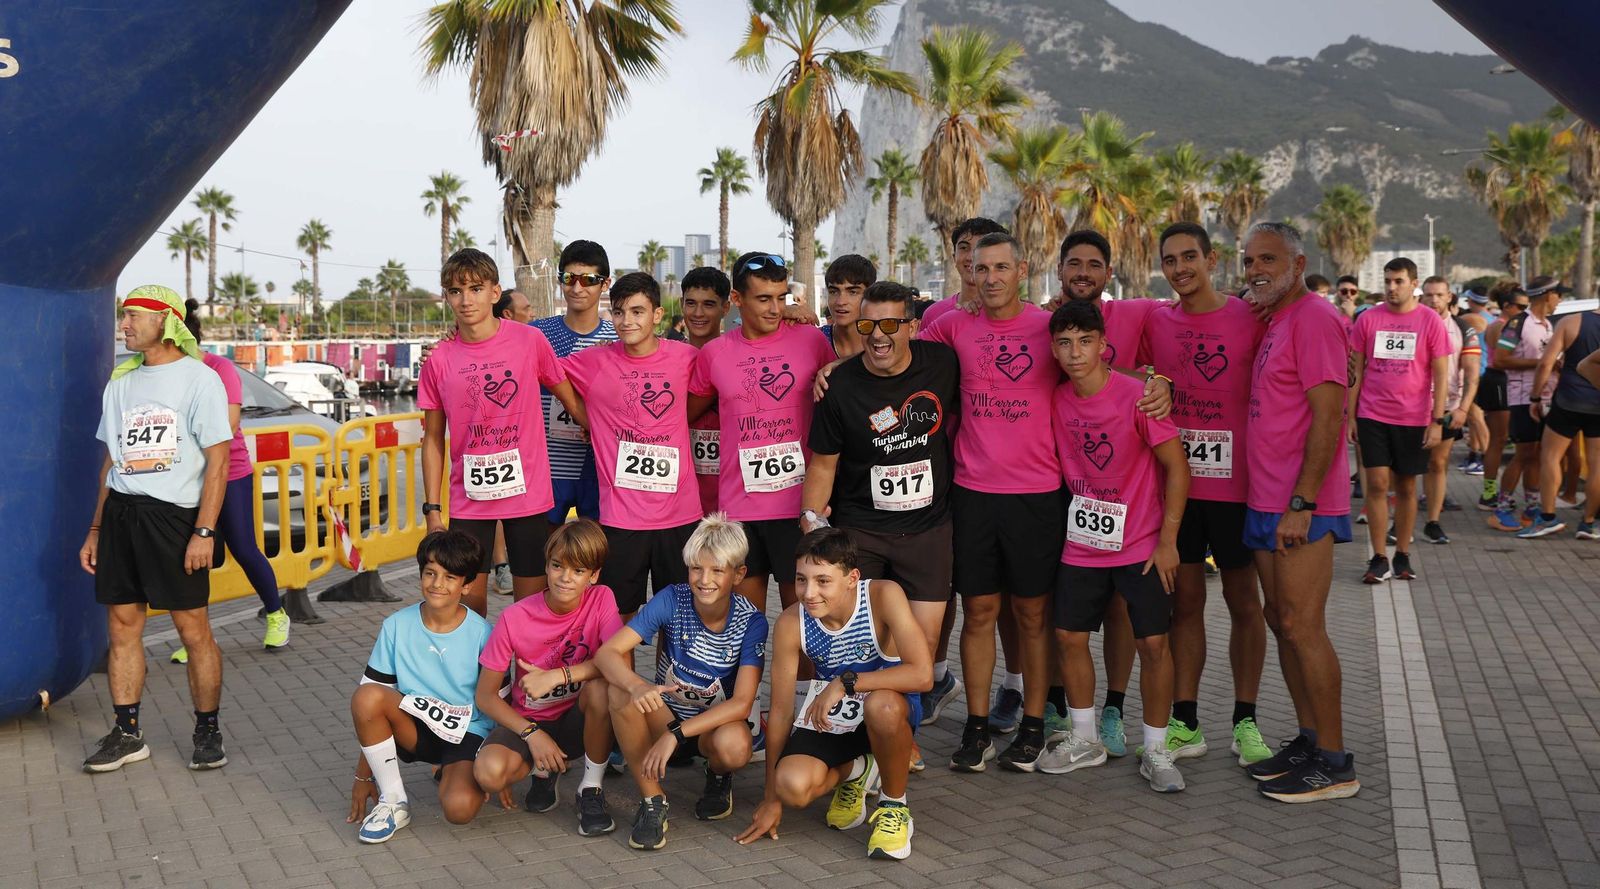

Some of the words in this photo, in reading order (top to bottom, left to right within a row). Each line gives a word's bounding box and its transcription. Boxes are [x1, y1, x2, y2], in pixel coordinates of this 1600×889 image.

[1386, 339, 1405, 350] 84
[970, 393, 988, 407] VIII
[988, 396, 1030, 408] Carrera
[738, 416, 756, 431] VIII
[756, 418, 793, 429] Carrera
[972, 408, 982, 417] de
[984, 408, 993, 417] la
[996, 408, 1031, 423] Mujer
[126, 426, 168, 446] 547
[484, 424, 518, 435] Carrera
[741, 432, 751, 441] de
[753, 431, 762, 440] la
[764, 428, 795, 442] Mujer
[468, 440, 478, 448] de
[481, 438, 490, 446] la
[635, 434, 671, 443] Carrera
[872, 432, 908, 447] Turismo
[884, 434, 928, 455] Running
[695, 442, 720, 460] 69
[625, 455, 671, 477] 289
[748, 455, 796, 478] 766
[470, 464, 516, 486] 552
[880, 474, 924, 496] 917
[1076, 510, 1114, 534] 639
[541, 682, 582, 699] 80
[676, 688, 716, 706] 07
[414, 697, 461, 730] 905
